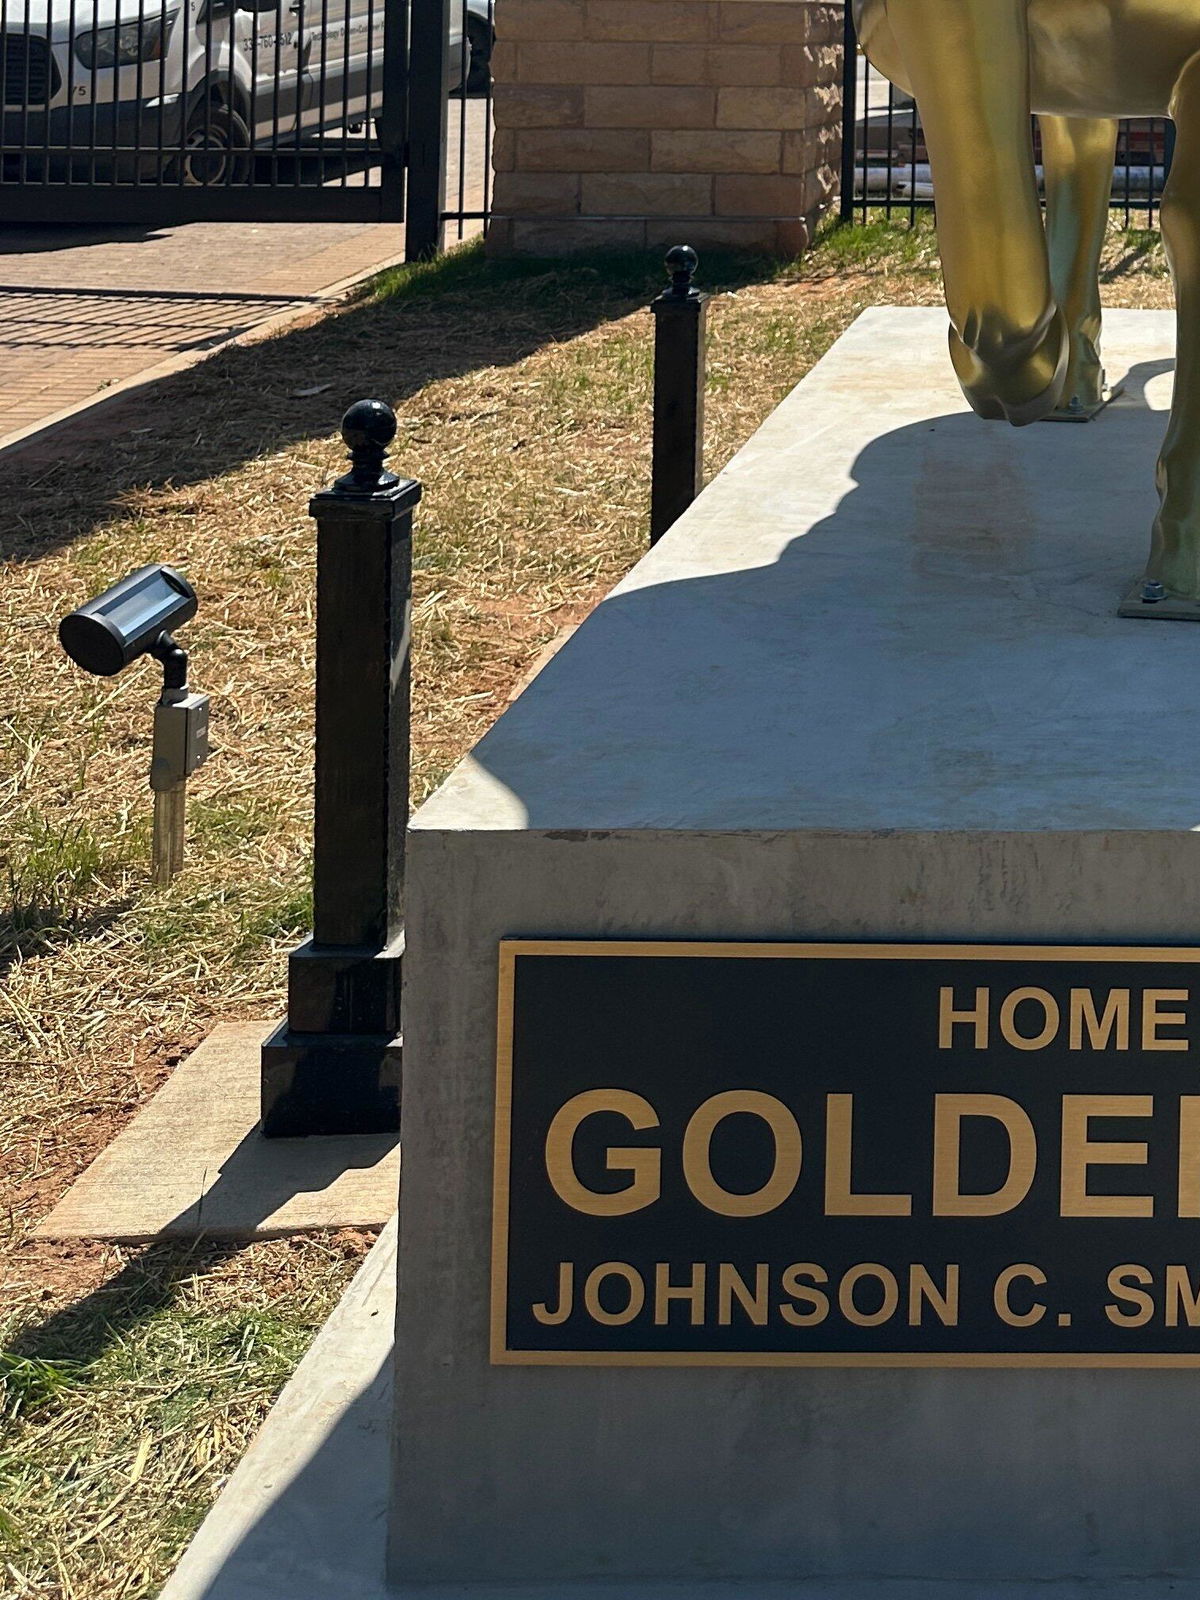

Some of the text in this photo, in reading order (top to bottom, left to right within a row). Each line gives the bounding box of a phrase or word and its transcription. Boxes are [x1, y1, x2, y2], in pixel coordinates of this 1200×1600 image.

[243, 31, 292, 52] 33-760-512
[937, 986, 1190, 1051] HOME
[531, 1262, 960, 1327] JOHNSON
[992, 1263, 1072, 1328] C.
